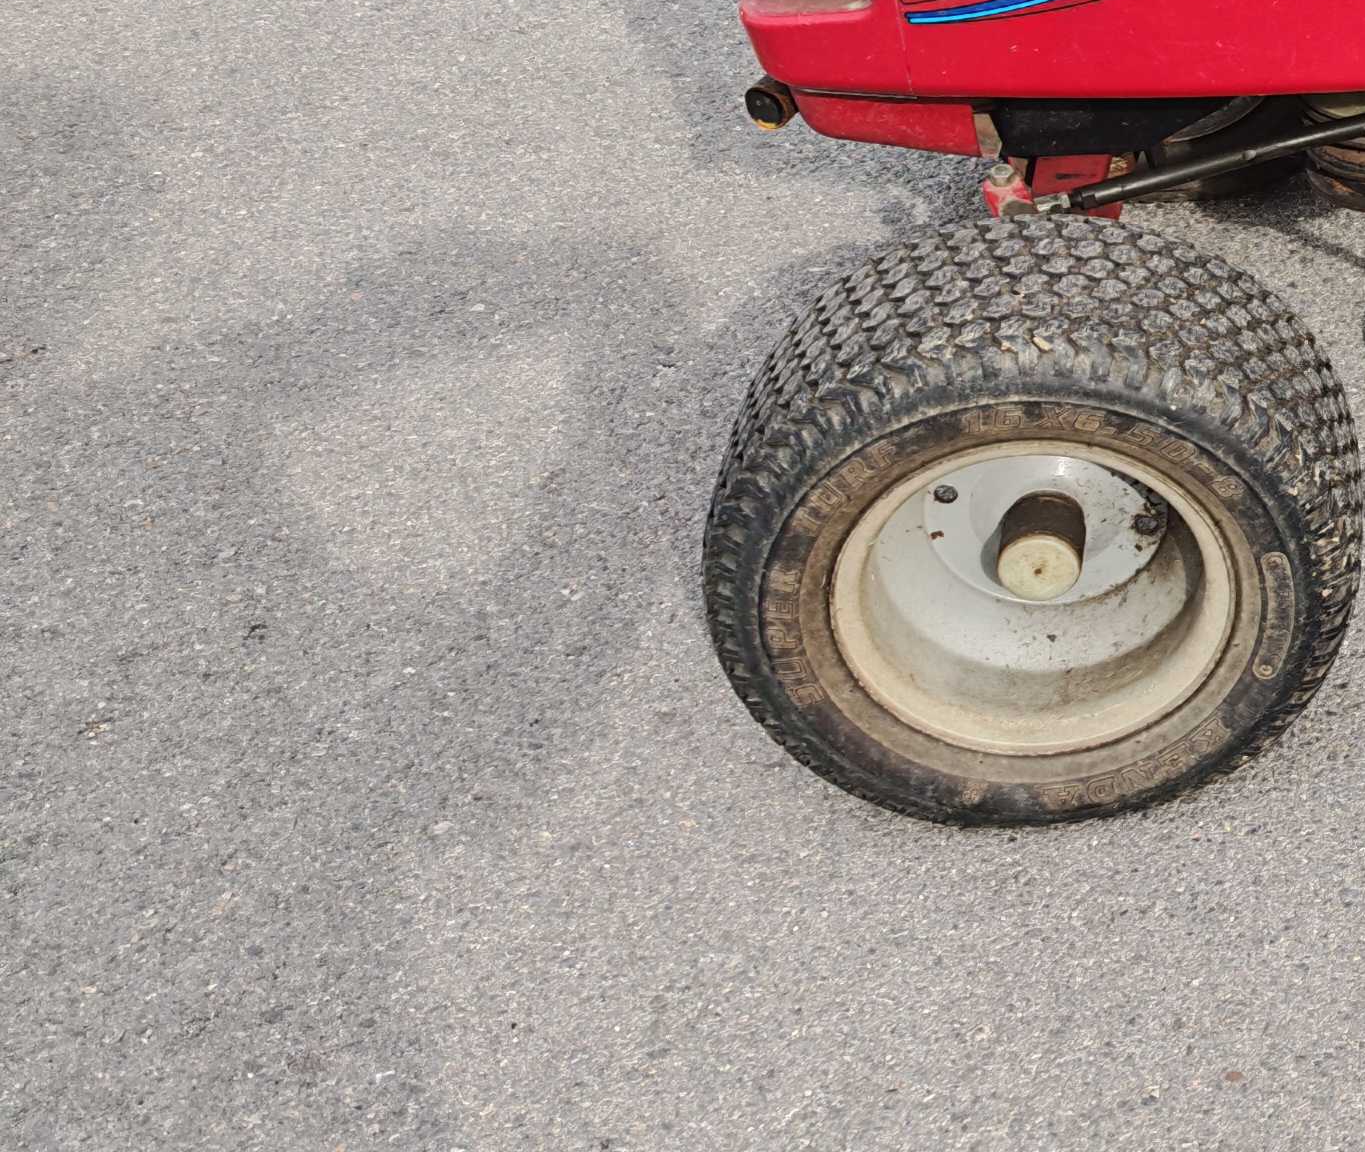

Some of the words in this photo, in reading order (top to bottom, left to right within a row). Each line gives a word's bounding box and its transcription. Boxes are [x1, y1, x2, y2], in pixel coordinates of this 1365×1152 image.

[790, 439, 899, 537] TURF
[766, 562, 826, 707] SUPER
[1035, 716, 1233, 813] KENDA
